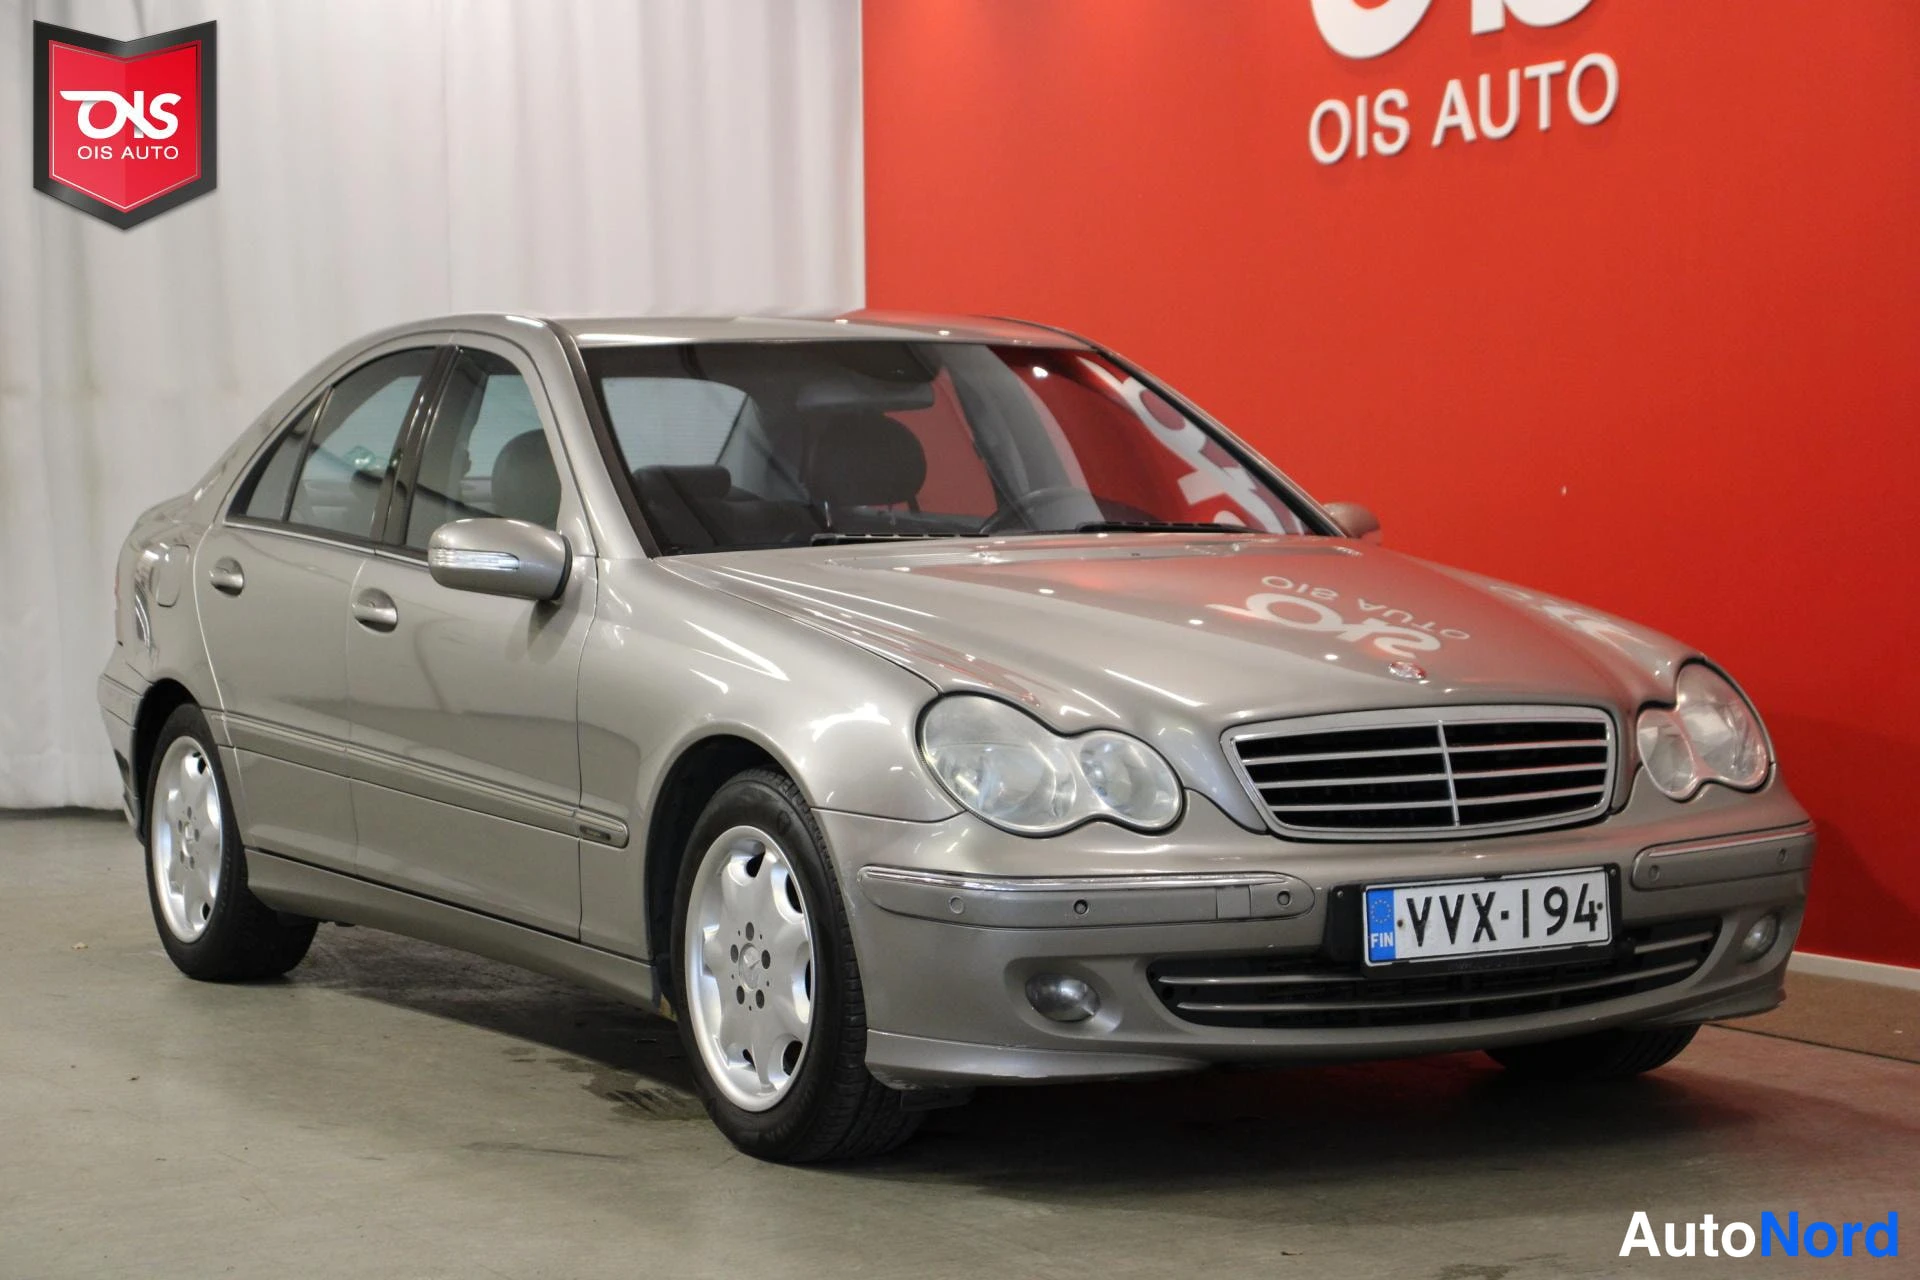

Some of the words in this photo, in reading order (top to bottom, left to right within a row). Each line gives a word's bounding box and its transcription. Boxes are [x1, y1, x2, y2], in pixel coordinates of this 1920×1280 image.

[1309, 88, 1411, 165] OIS
[1431, 53, 1619, 148] AUTO
[1370, 932, 1394, 949] FIN
[1406, 883, 1598, 947] VVX-194
